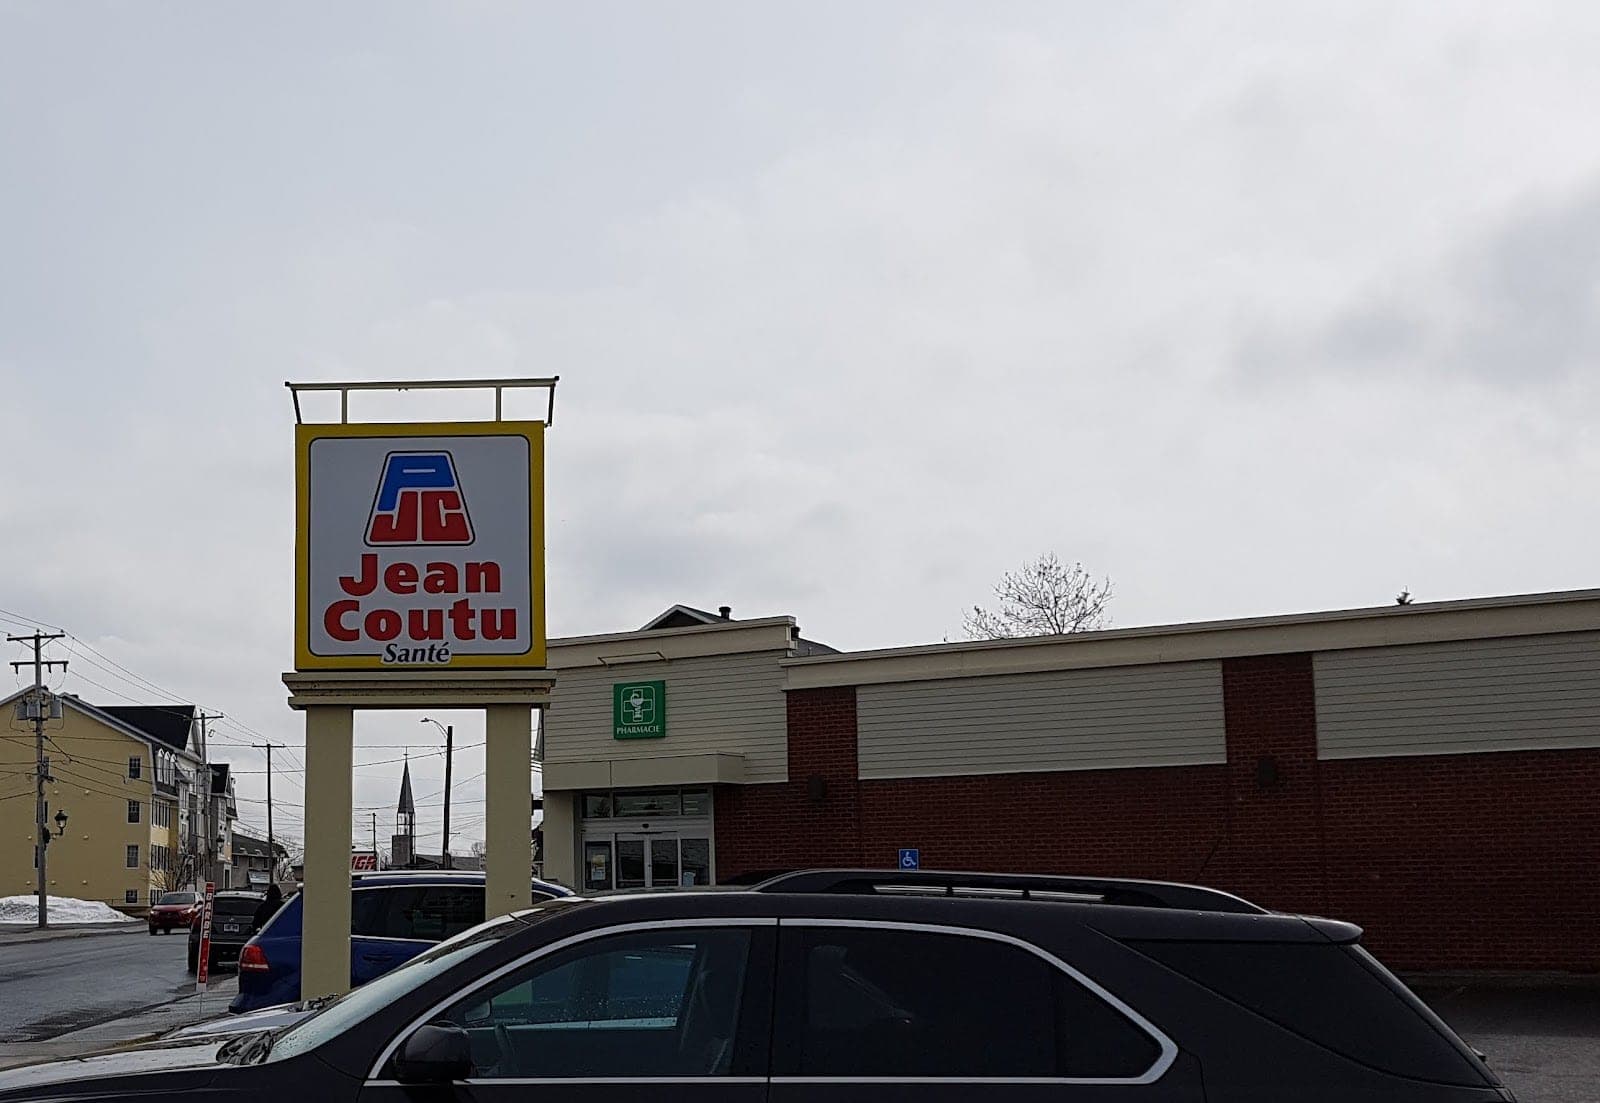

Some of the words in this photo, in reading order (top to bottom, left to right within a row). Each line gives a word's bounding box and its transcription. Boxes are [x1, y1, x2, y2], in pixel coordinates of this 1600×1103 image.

[338, 553, 501, 597] Jean
[323, 598, 517, 642] Coutu
[383, 641, 451, 664] Santé
[616, 725, 661, 735] PHARMACIE
